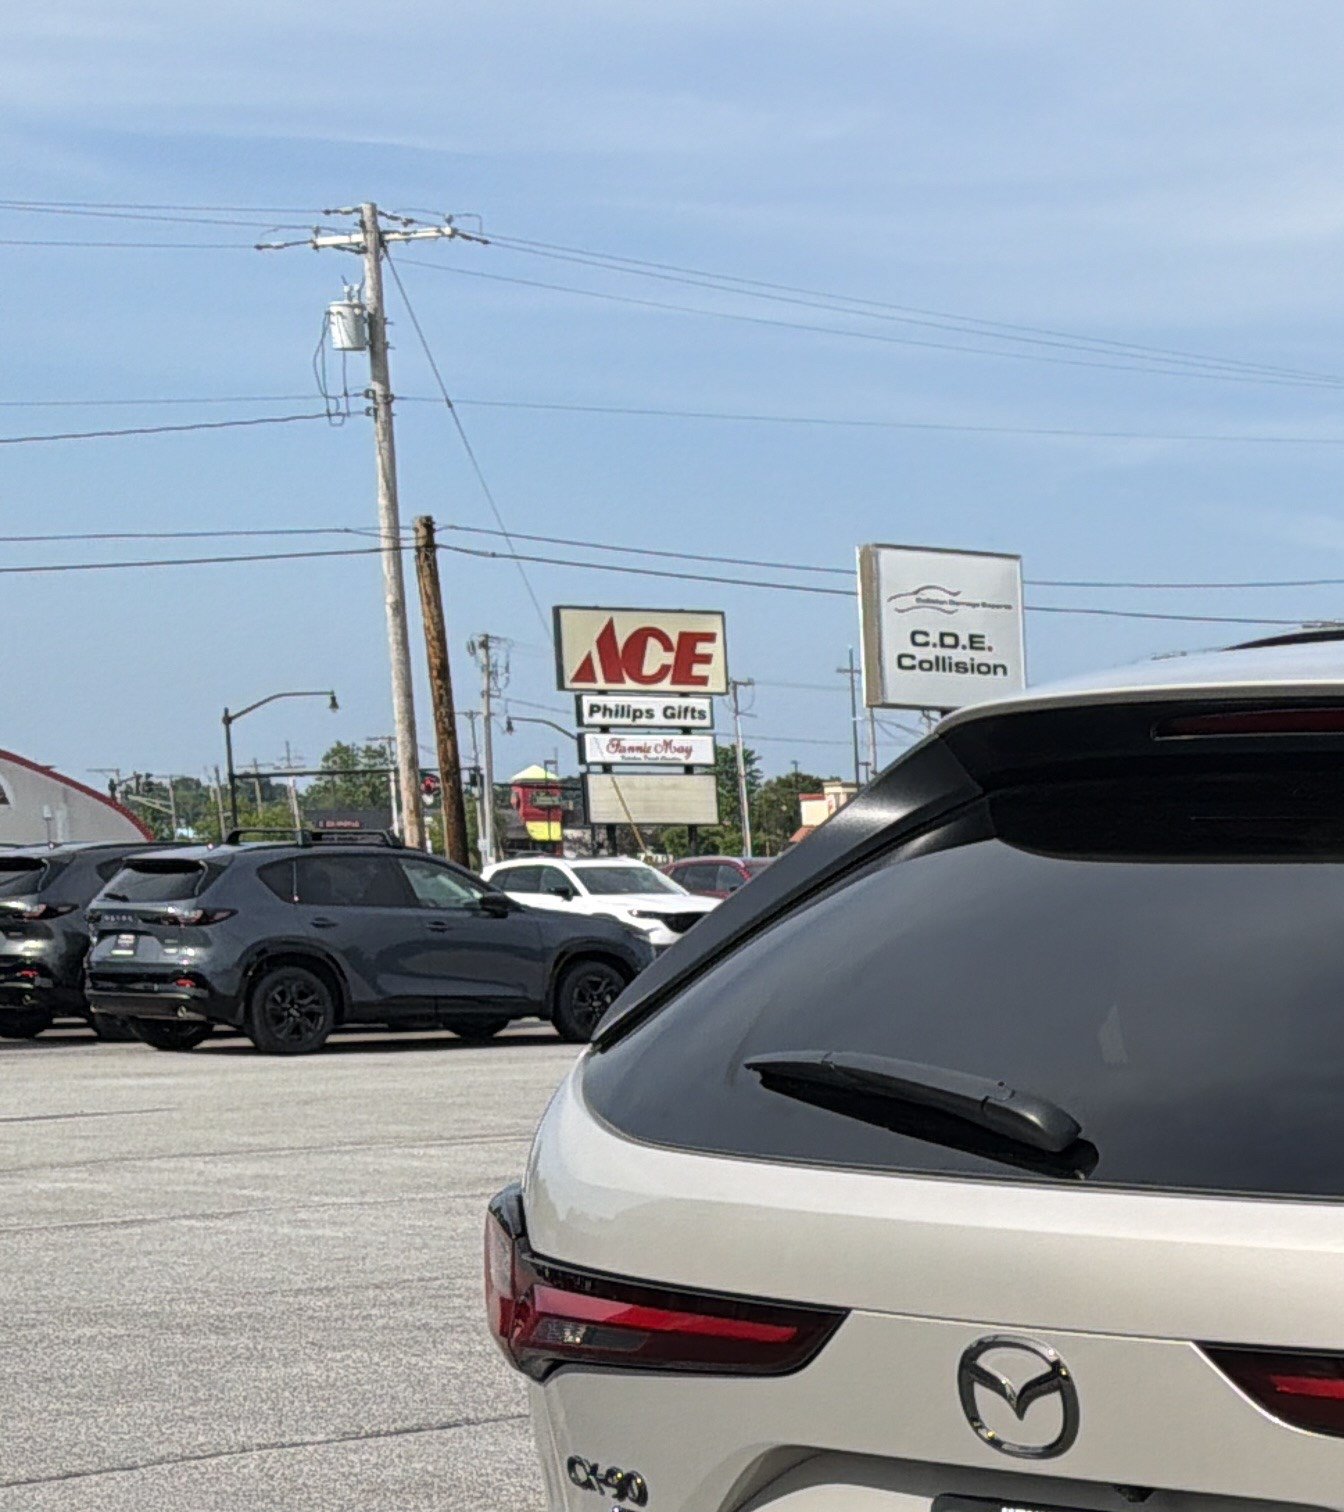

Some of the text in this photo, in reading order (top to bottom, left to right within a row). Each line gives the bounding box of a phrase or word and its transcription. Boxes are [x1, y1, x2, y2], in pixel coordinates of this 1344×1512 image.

[570, 616, 717, 686] ACE
[910, 629, 993, 652] C.D.E.
[897, 653, 1008, 676] Collision
[588, 703, 707, 722] Philips Gifts
[606, 737, 693, 760] Fannie May
